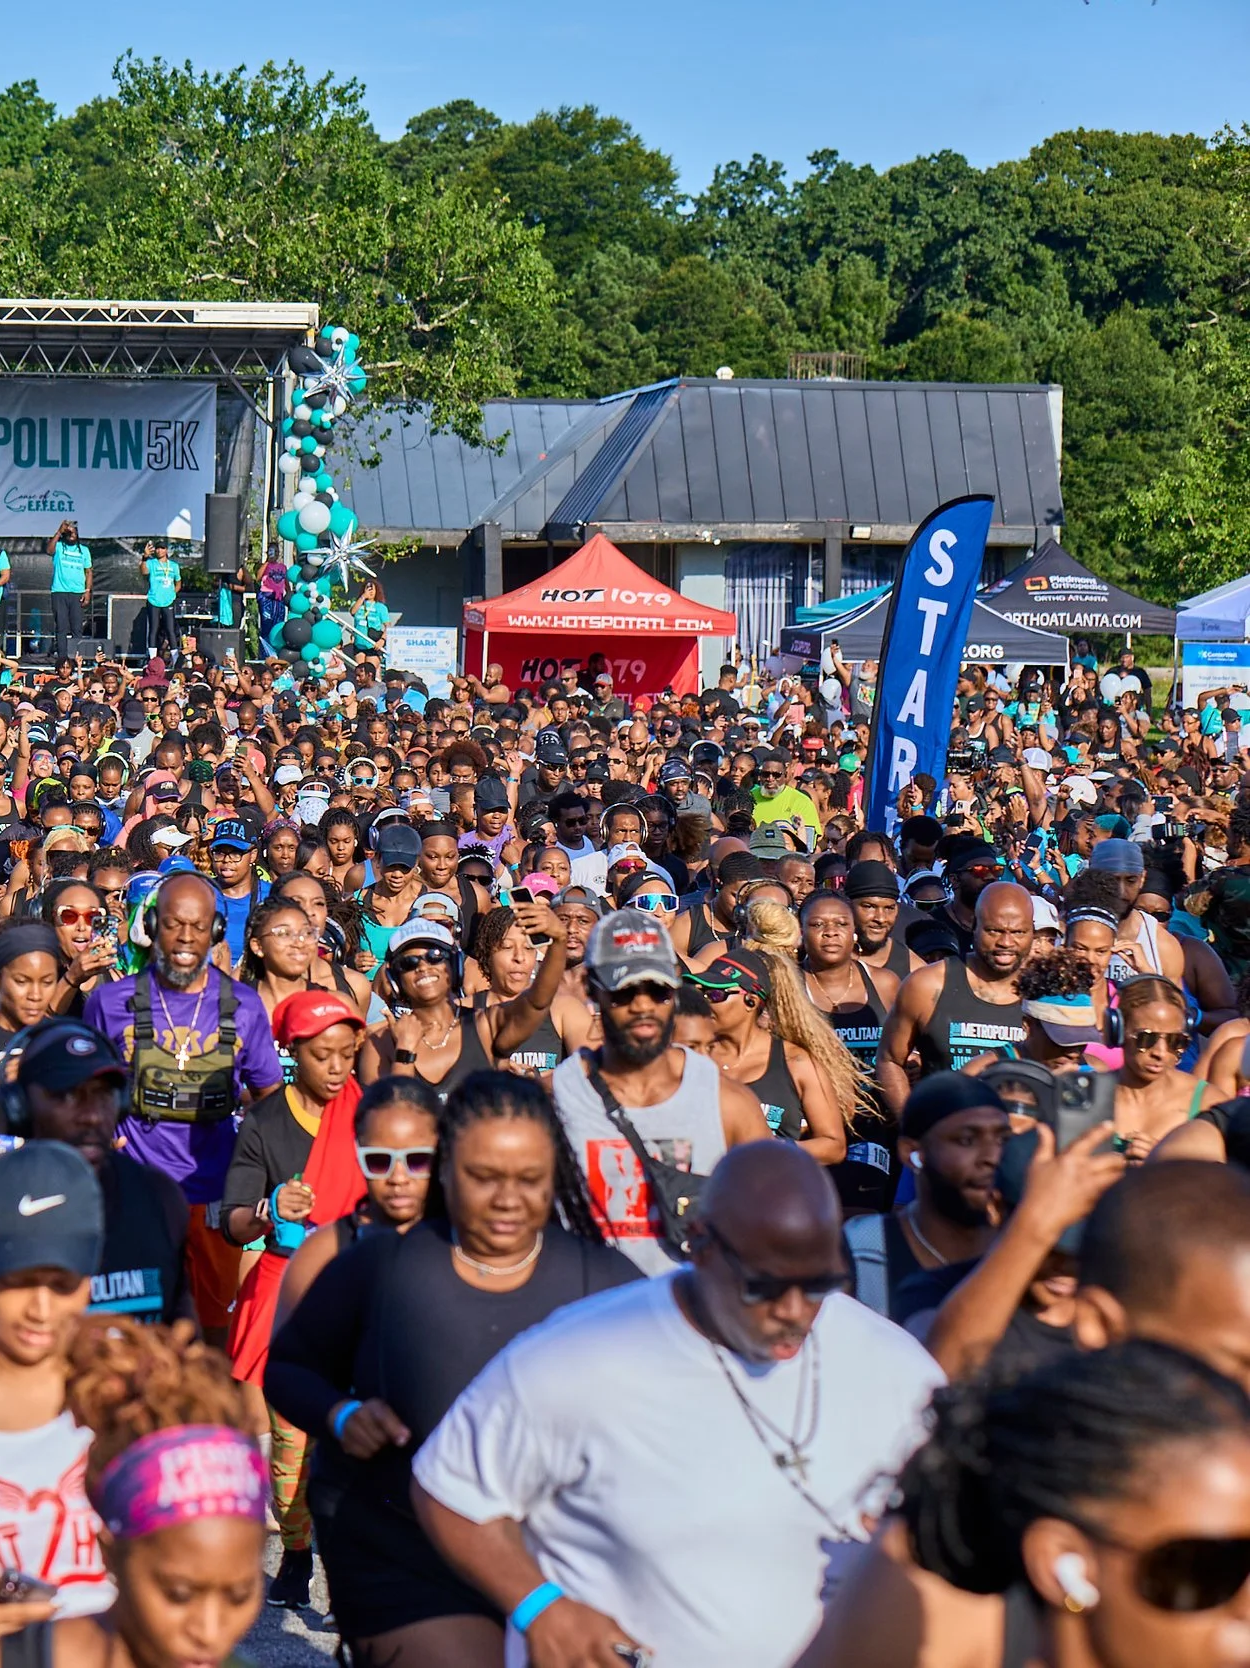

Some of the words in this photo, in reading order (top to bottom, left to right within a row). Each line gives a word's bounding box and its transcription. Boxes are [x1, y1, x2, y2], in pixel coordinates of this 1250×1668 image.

[147, 420, 200, 471] 5K
[1049, 575, 1097, 584] Piedmont
[1050, 582, 1108, 591] Orthopedics
[541, 588, 607, 603] HOT
[508, 615, 713, 631] WWW.HOTSPOTATL.COM
[406, 639, 437, 647] SHARK
[963, 644, 1004, 659] .ORG
[216, 821, 245, 840] ZETA
[91, 1269, 145, 1302] OLITAN
